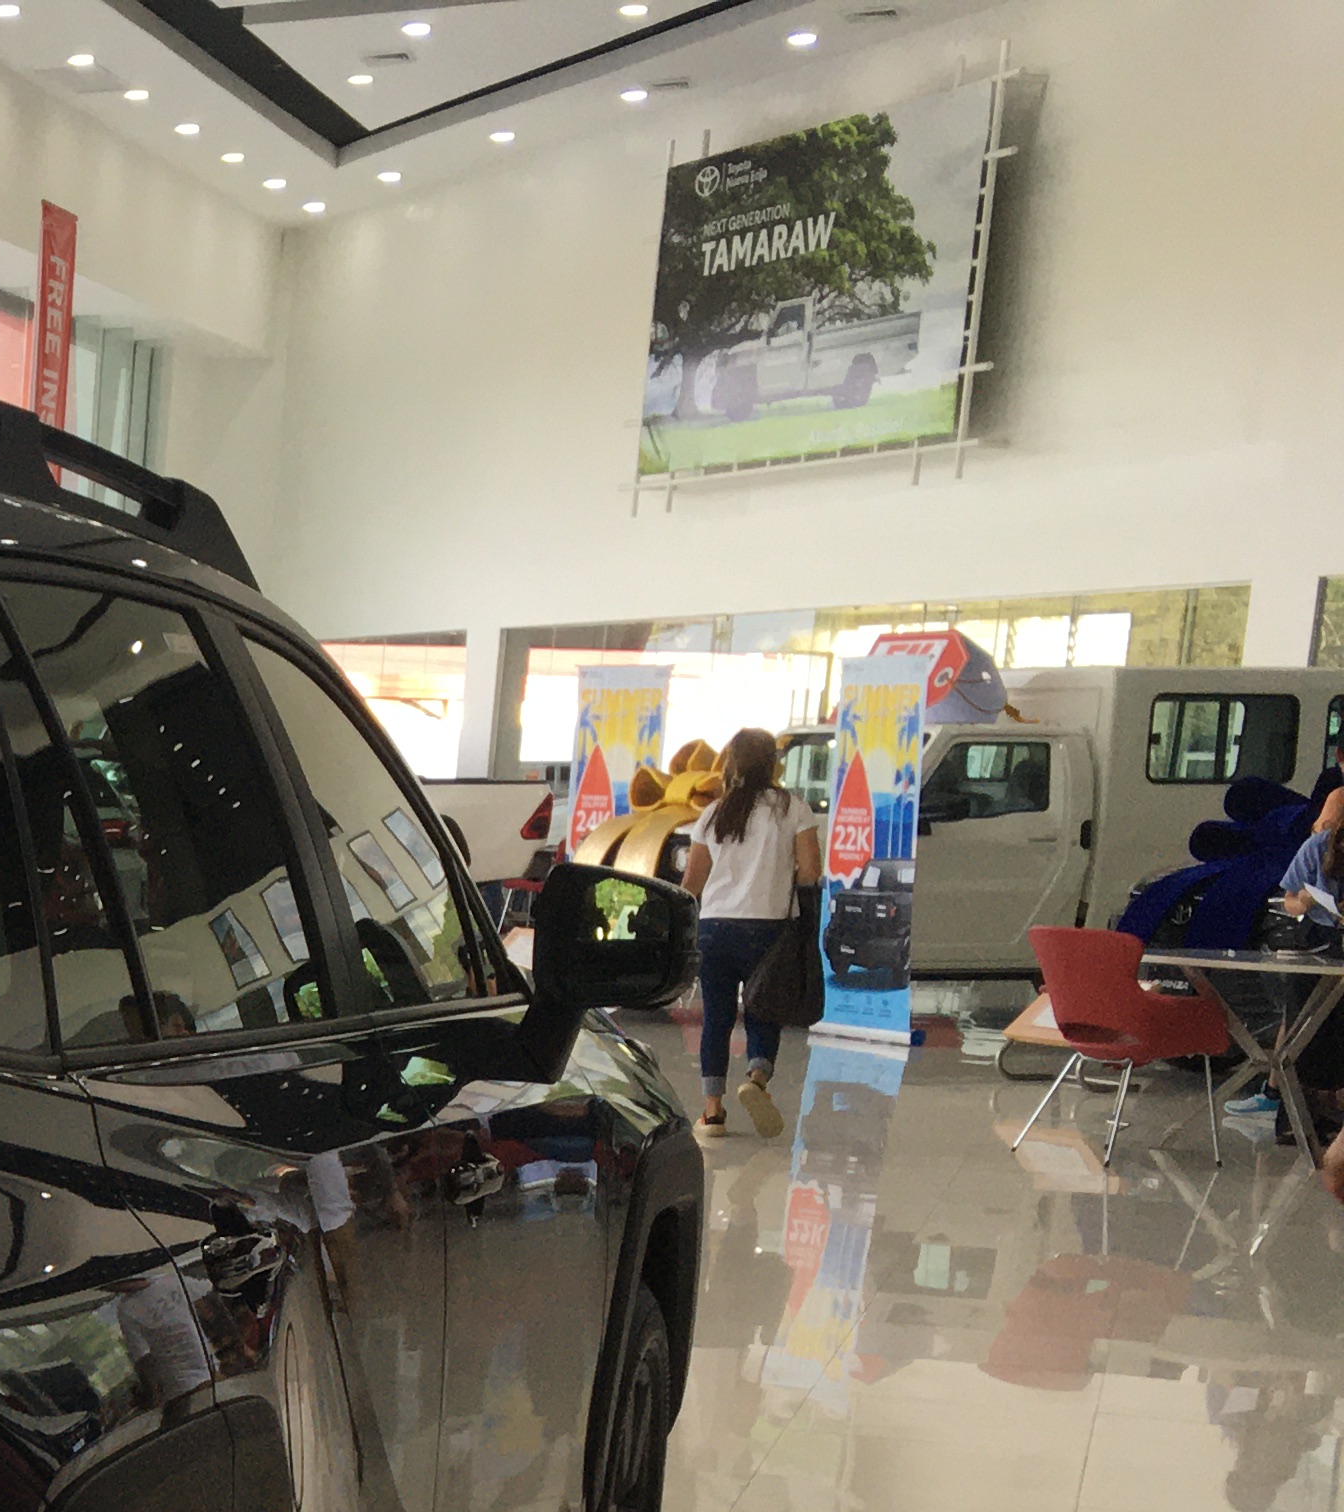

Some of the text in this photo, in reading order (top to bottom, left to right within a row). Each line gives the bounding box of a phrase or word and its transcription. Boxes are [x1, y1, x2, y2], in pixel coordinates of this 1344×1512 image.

[727, 202, 791, 231] GENERATION
[701, 211, 836, 277] TAMARAW
[43, 253, 69, 359] FREE
[834, 824, 871, 852] 22K
